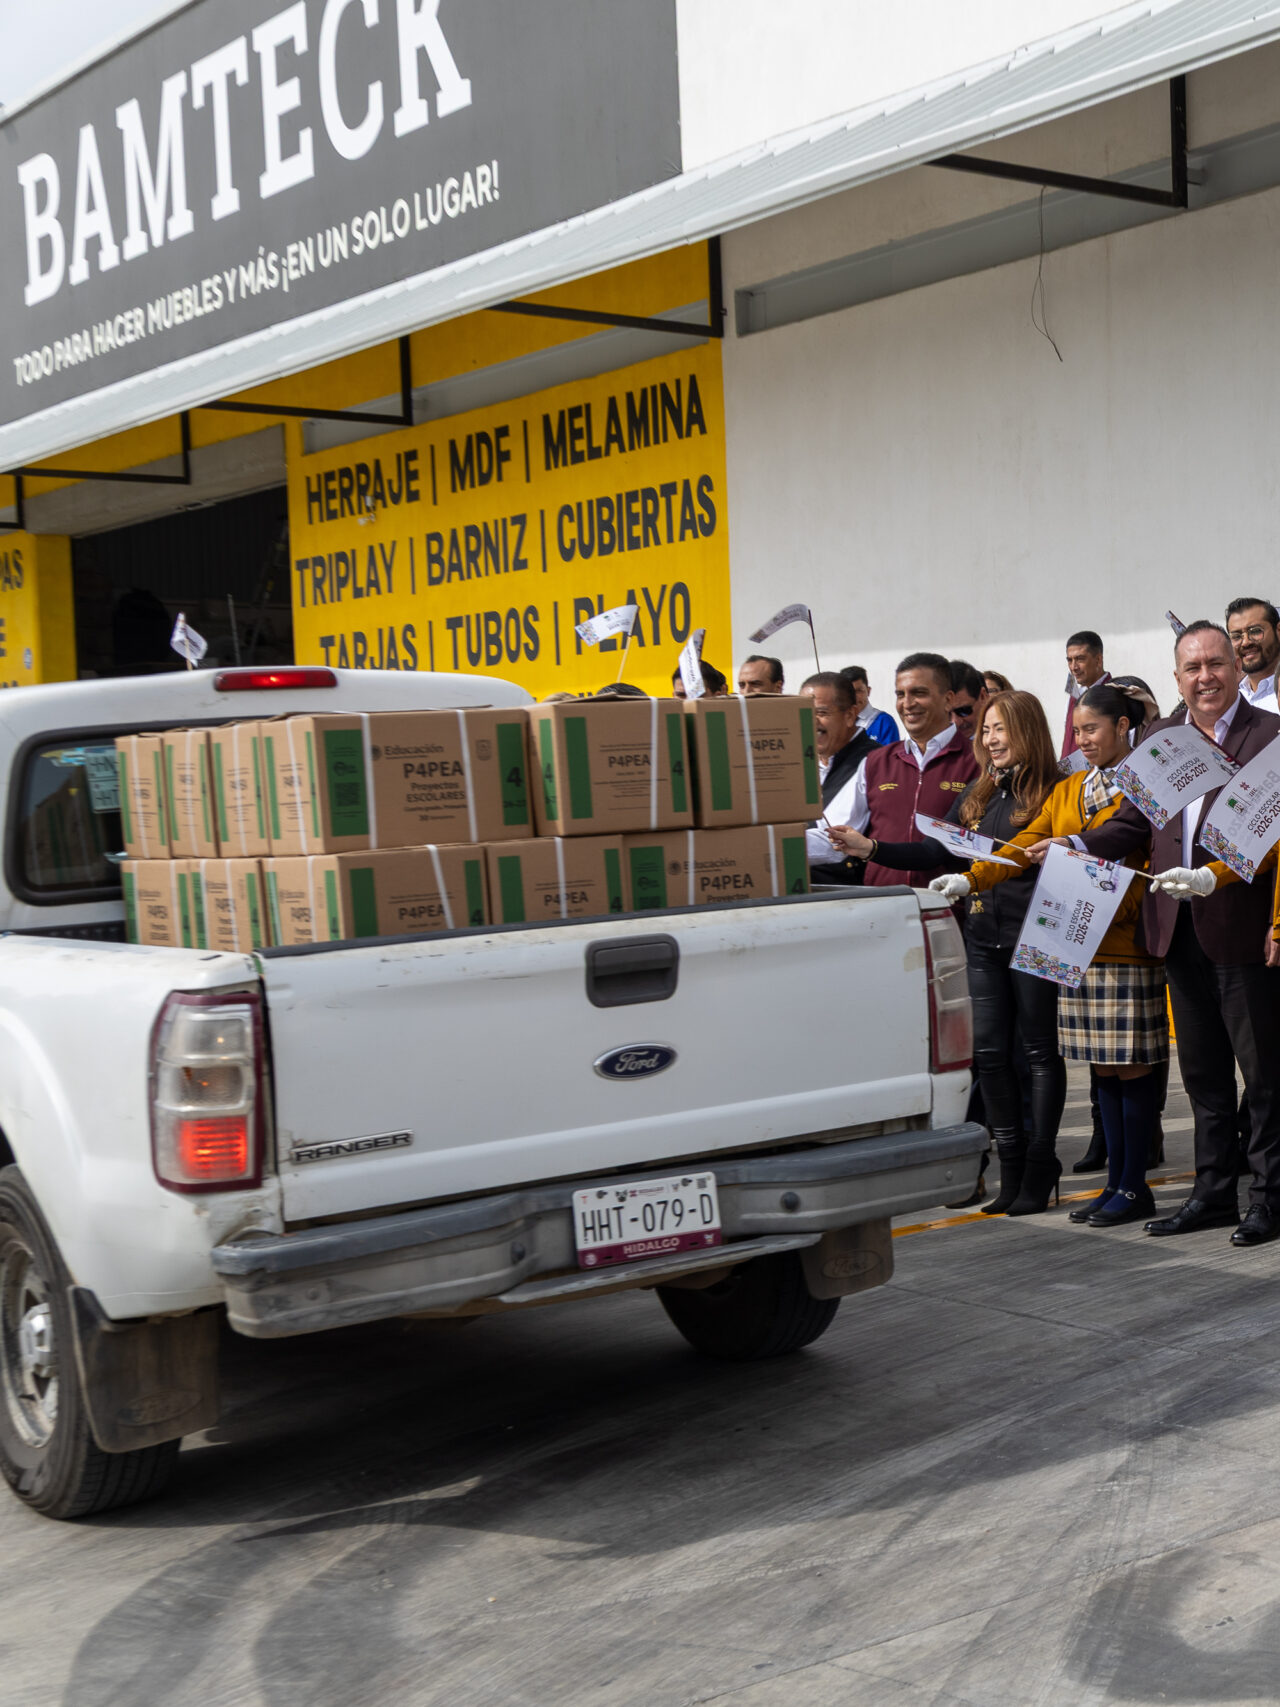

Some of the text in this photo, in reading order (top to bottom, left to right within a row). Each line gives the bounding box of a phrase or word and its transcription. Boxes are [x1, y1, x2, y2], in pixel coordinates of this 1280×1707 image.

[18, 0, 472, 307] BAMTECK
[14, 159, 500, 386] TODO PARA HACER MUEBLES Y MÁS ¡EN UN SOLO LUGAR!
[306, 374, 708, 525] HERRAJE MDF MELAMINA
[295, 474, 718, 608] TRIPLAY BARNIZ CUBIERTAS
[319, 623, 418, 671] TARJAS
[445, 604, 540, 670] TUBOS
[751, 738, 785, 751] 4PEA
[804, 744, 815, 760] 4
[403, 760, 464, 778] P4PEA
[608, 754, 652, 768] P4PEA
[672, 760, 684, 777] 4
[506, 766, 522, 788] 4
[1167, 769, 1182, 783] CICLO
[1172, 762, 1209, 792] 2026-2027
[406, 791, 466, 803] ESCOLARES
[1247, 791, 1280, 831] CICLO ESCOLAR
[700, 873, 754, 892] P4PEA
[1065, 899, 1084, 941] CICLO ESCOLAR
[1073, 901, 1096, 945] 2026-2027
[615, 1050, 660, 1073] Ford
[295, 1133, 411, 1162] RANGER
[582, 1193, 713, 1243] HHT-079-D
[623, 1237, 681, 1255] HIDALGO
